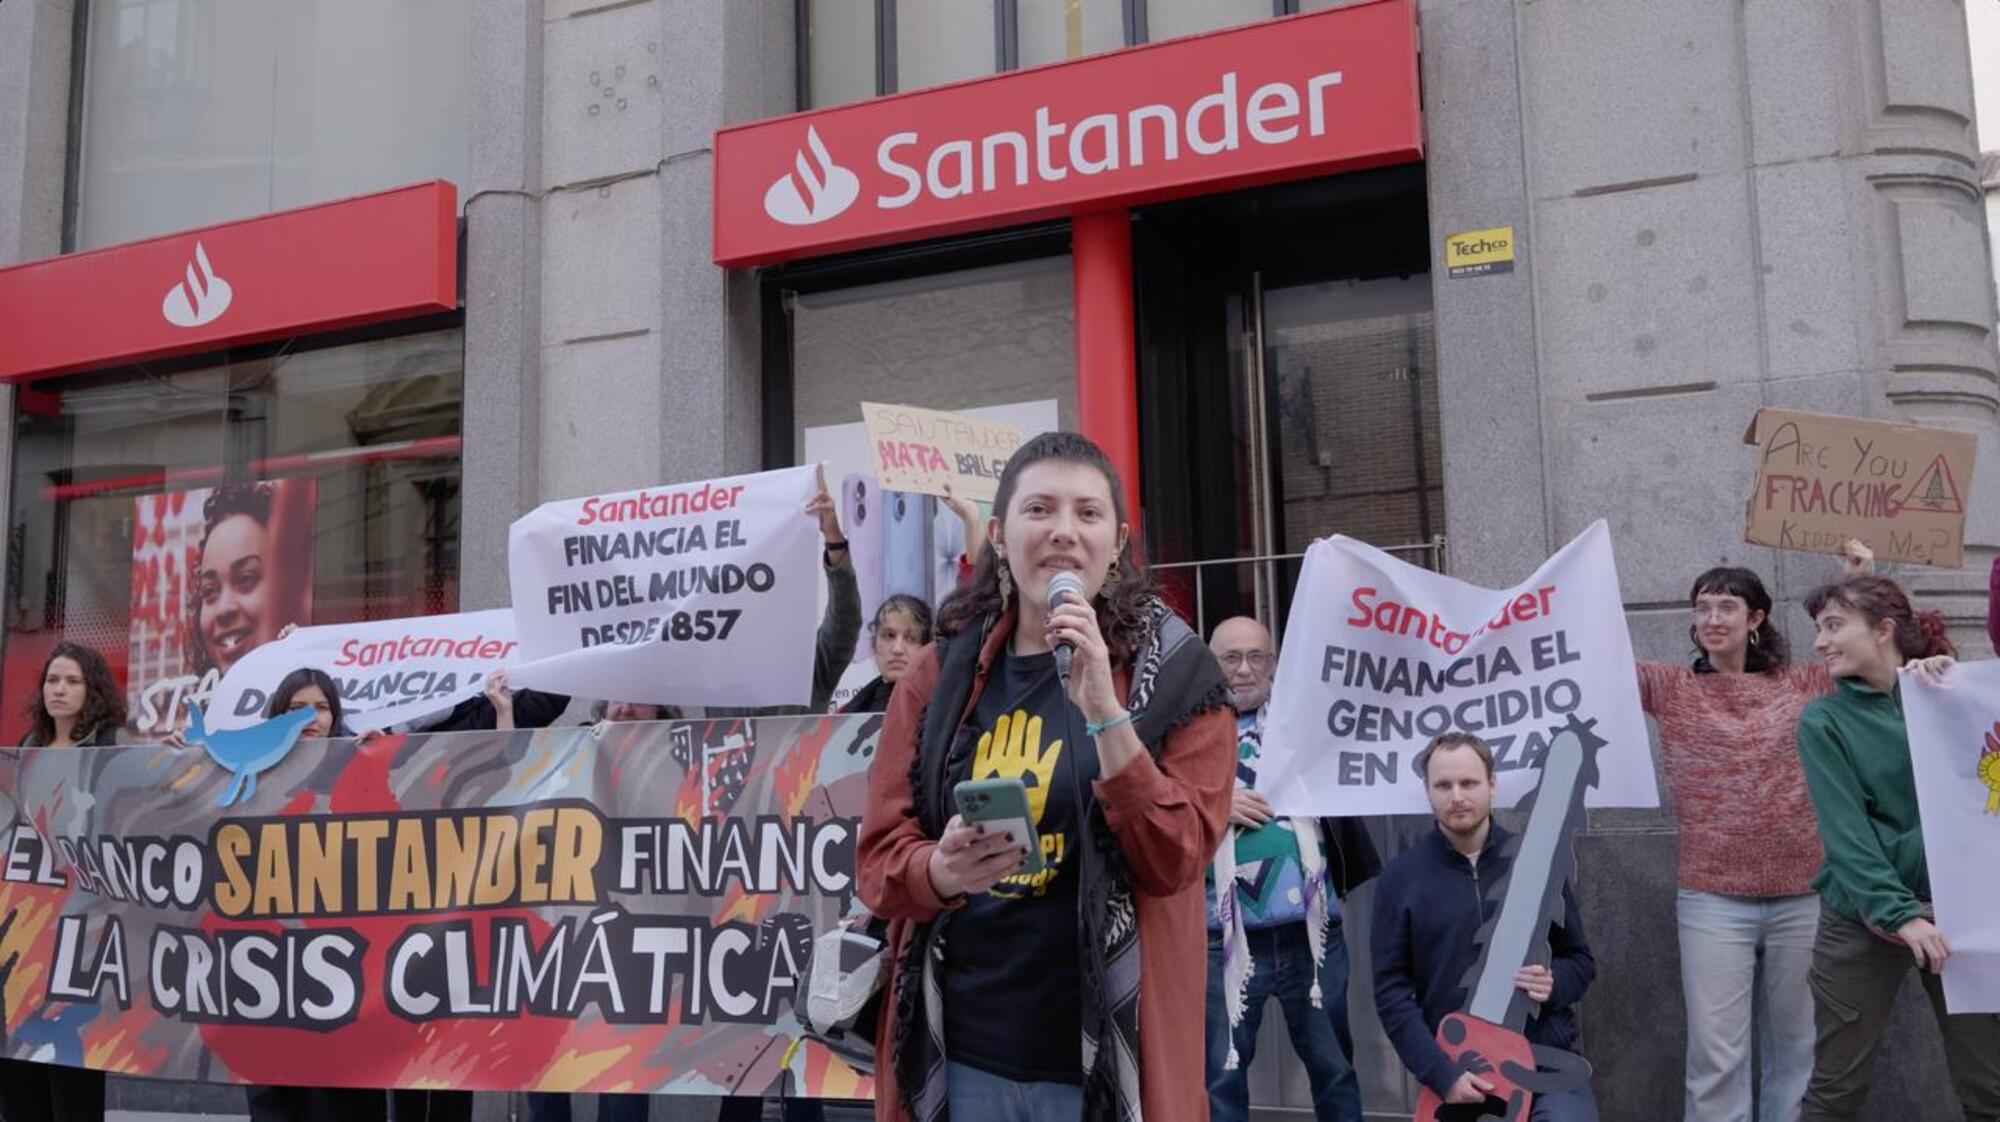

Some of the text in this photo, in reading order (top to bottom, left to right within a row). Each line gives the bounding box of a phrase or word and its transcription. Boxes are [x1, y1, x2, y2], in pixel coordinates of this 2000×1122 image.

[877, 72, 1342, 209] Santander
[875, 409, 1022, 451] SANTANDER
[877, 440, 1009, 480] MATA BALLE
[1853, 436, 1908, 480] YOU
[577, 484, 744, 525] Santander
[1766, 475, 1902, 518] FRACKING
[564, 519, 746, 567] FINANCIA EL
[548, 562, 775, 615] FIN DEL MUNDO
[661, 608, 743, 642] 1857
[1348, 585, 1556, 655] Santader
[334, 635, 518, 668] Santander
[1321, 630, 1581, 697] FINANCIA EL
[1328, 678, 1582, 741] GENOCIDIO
[1338, 751, 1398, 786] EN
[5, 826, 67, 885] EL
[59, 839, 203, 904] BANCO
[214, 808, 603, 916] SANTANDER
[51, 911, 799, 1020] LA CRISIS CLIMÁTICA
